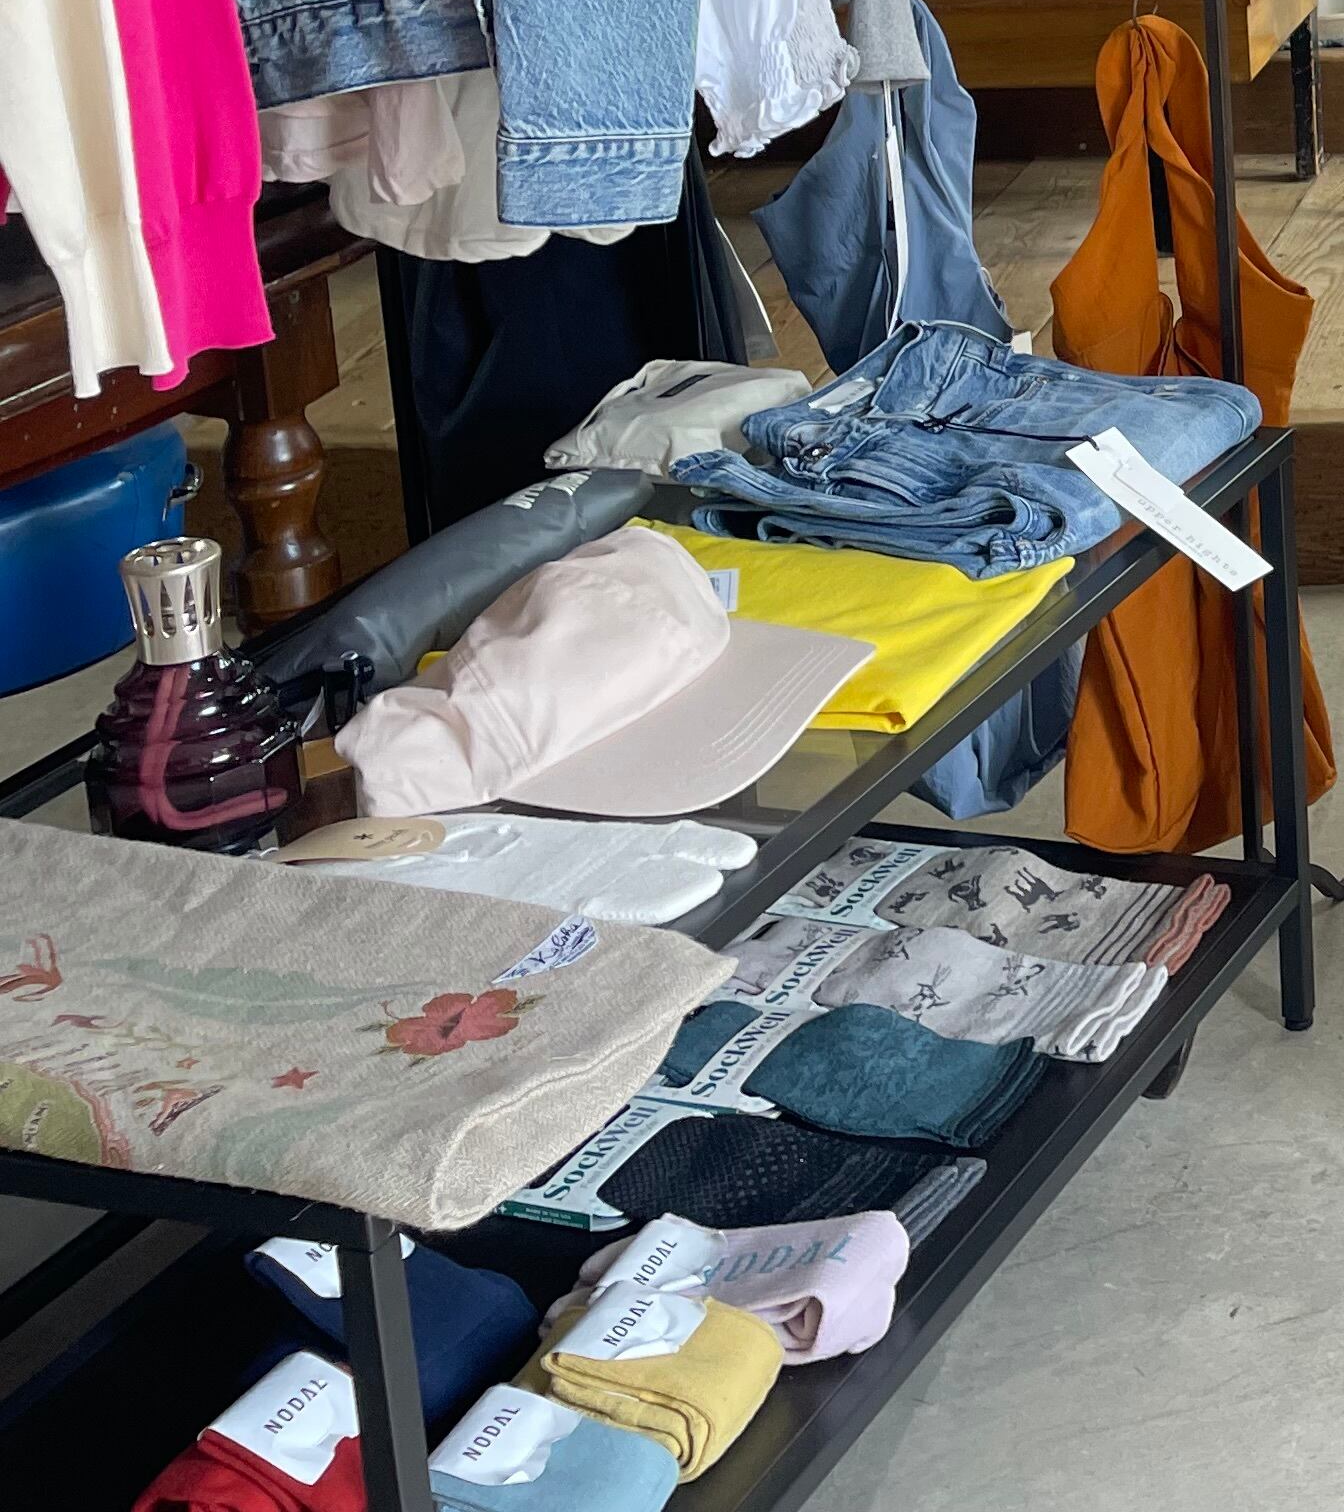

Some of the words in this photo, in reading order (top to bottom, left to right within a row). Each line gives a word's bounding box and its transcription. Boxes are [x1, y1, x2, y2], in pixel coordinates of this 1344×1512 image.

[1137, 497, 1183, 534] upper
[632, 1238, 678, 1286] NODAL
[602, 1298, 654, 1348] NODAL
[263, 1379, 328, 1434] NODAL
[462, 1405, 521, 1462] NODAL
